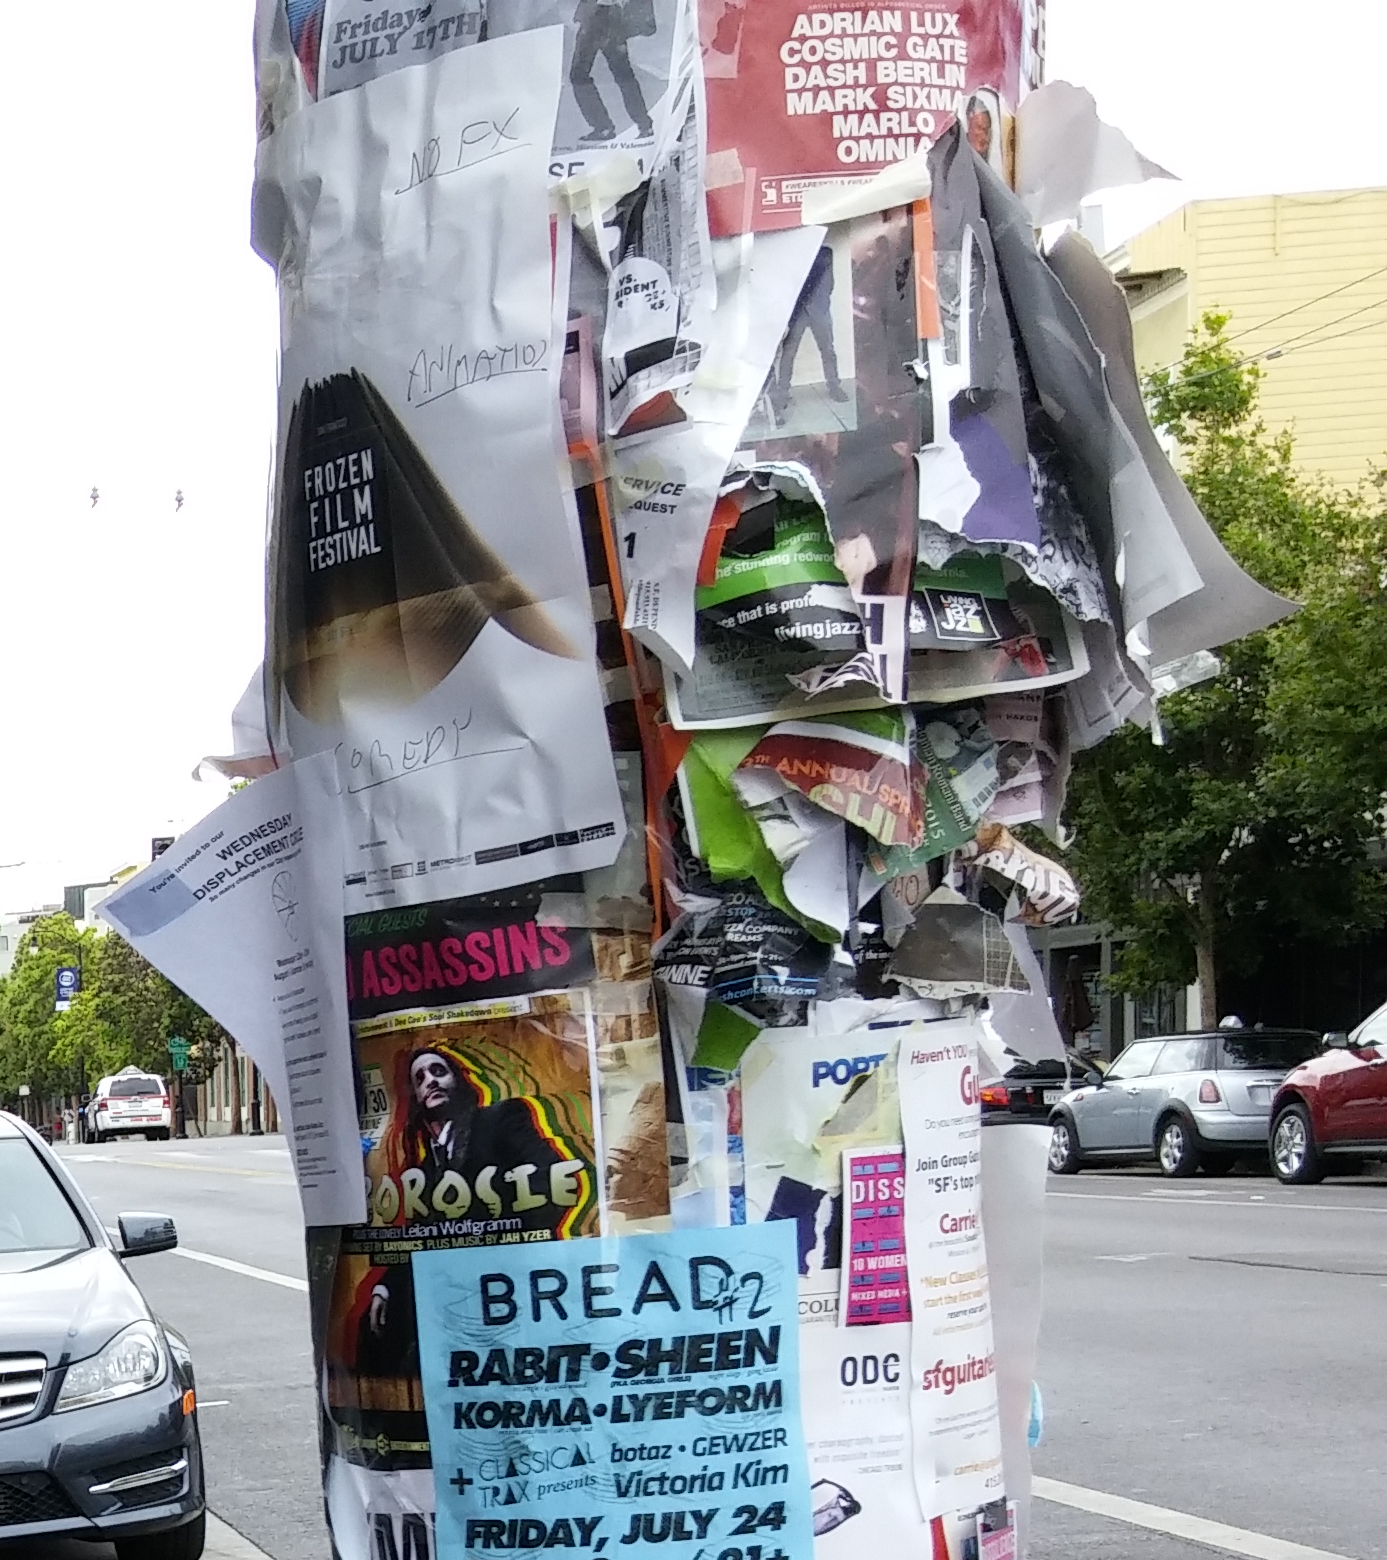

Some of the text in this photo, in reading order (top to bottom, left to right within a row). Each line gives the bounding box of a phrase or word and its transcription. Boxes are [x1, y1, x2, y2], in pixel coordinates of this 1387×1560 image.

[791, 11, 959, 38] ADRIAN LUX
[332, 33, 409, 69] JULY
[780, 36, 968, 64] COSMIC GATE
[784, 61, 966, 90] DASH BERLIN
[787, 88, 877, 116] MARK
[833, 112, 935, 138] MARLO
[837, 137, 932, 163] OMNIA
[304, 448, 374, 500] FROZEN
[309, 485, 373, 537] FILM
[309, 523, 381, 572] FESTIVAL
[737, 609, 762, 626] that
[776, 757, 879, 795] ANNUAL
[216, 812, 294, 861] WEDNESDAY
[175, 848, 202, 873] invited
[193, 834, 289, 901] DISPLACEMENT
[362, 915, 570, 998] ASSASSINS
[915, 1151, 968, 1172] Join Group
[427, 1236, 449, 1249] PLUS
[452, 1235, 483, 1247] MUSIC
[486, 1233, 497, 1244] BY
[500, 1231, 520, 1243] JAH
[523, 1230, 551, 1242] YZER
[439, 1217, 522, 1236] Wolfgramm
[479, 1255, 735, 1327] BREAD
[448, 1325, 782, 1388] RABIT SHEEN
[841, 1353, 900, 1386] ODC
[453, 1380, 783, 1430] KORMA LYEFORM
[479, 1442, 596, 1481] CLASSICAL
[611, 1442, 672, 1463] botaz
[692, 1428, 789, 1456] GEWZER
[537, 1473, 597, 1499] presents
[613, 1465, 724, 1498] Victoria
[731, 1461, 789, 1490] Kim
[465, 1501, 787, 1552] FRIDAY, JULY 24
